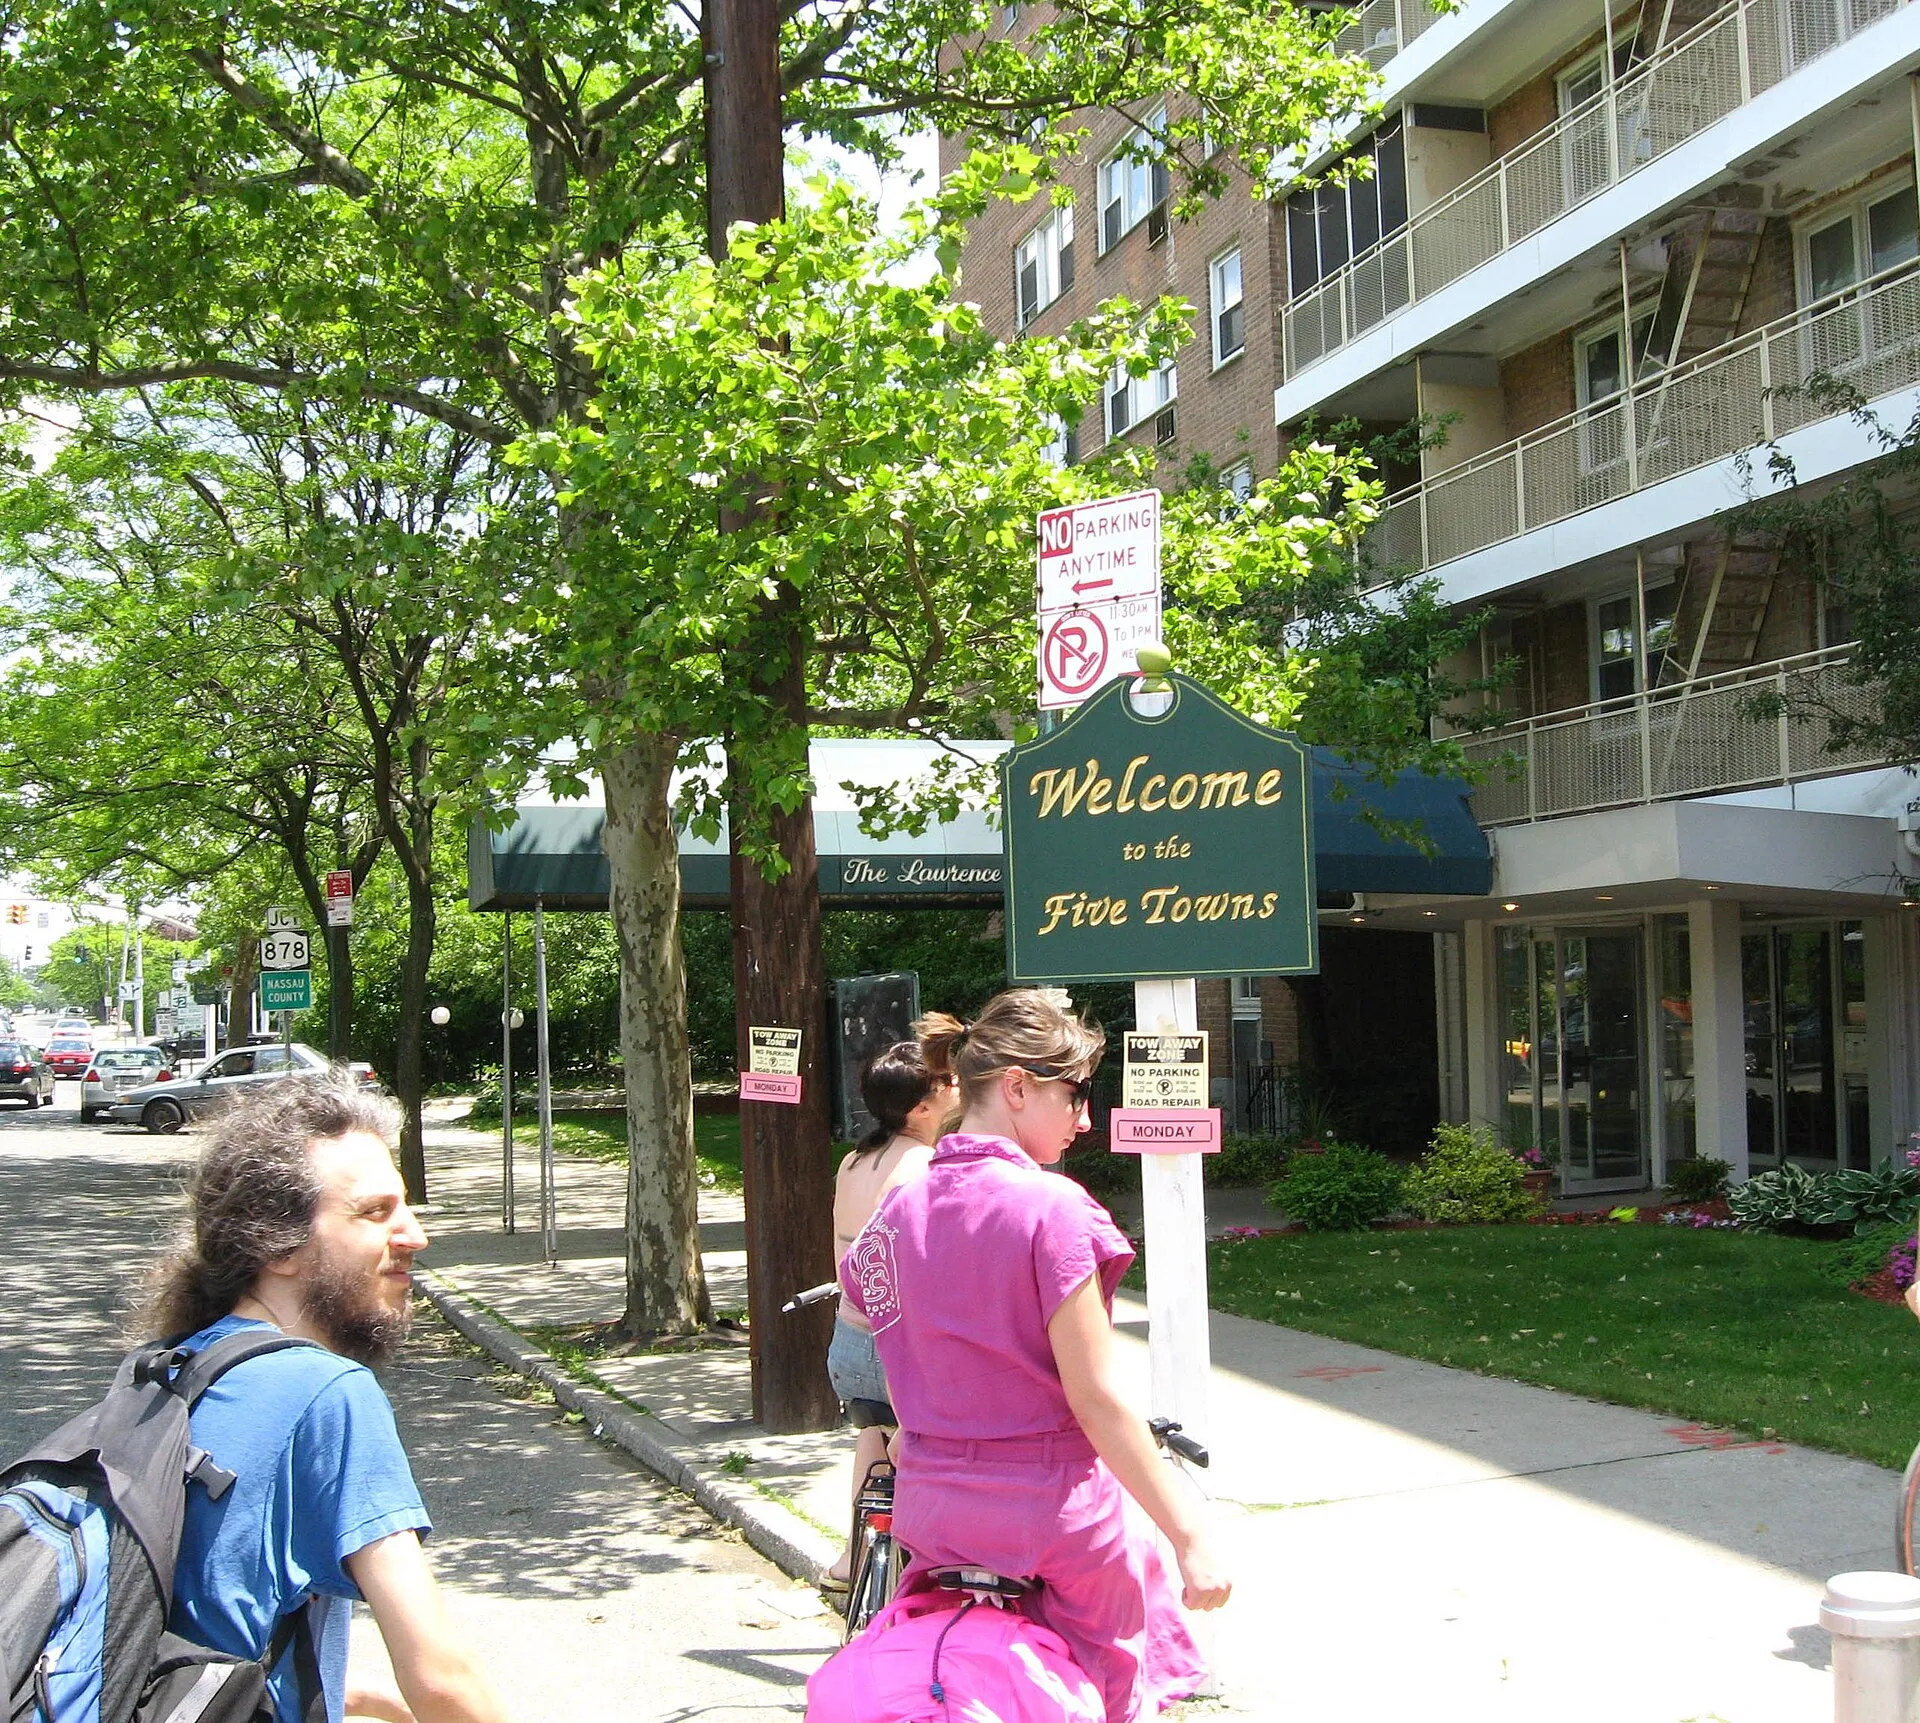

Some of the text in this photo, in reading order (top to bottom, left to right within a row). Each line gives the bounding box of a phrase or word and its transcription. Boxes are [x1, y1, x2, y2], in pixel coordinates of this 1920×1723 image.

[1042, 508, 1152, 553] NO PARKING
[1058, 546, 1137, 578] ANYTIME
[1029, 754, 1283, 819] Welcome
[1123, 834, 1192, 862] to the
[843, 858, 1002, 885] The Lawrence
[1038, 884, 1279, 936] Five Towns
[264, 941, 305, 960] 878
[266, 978, 304, 990] NASSAU
[268, 992, 304, 1002] COUNTY
[1130, 1038, 1202, 1050] TOW AWAY
[1146, 1050, 1186, 1061] ZONE
[1130, 1068, 1200, 1077] NO PARKING
[754, 1082, 788, 1092] MONDAY
[1130, 1098, 1202, 1107] ROAD REPAIR
[1132, 1126, 1196, 1138] MONDAY
